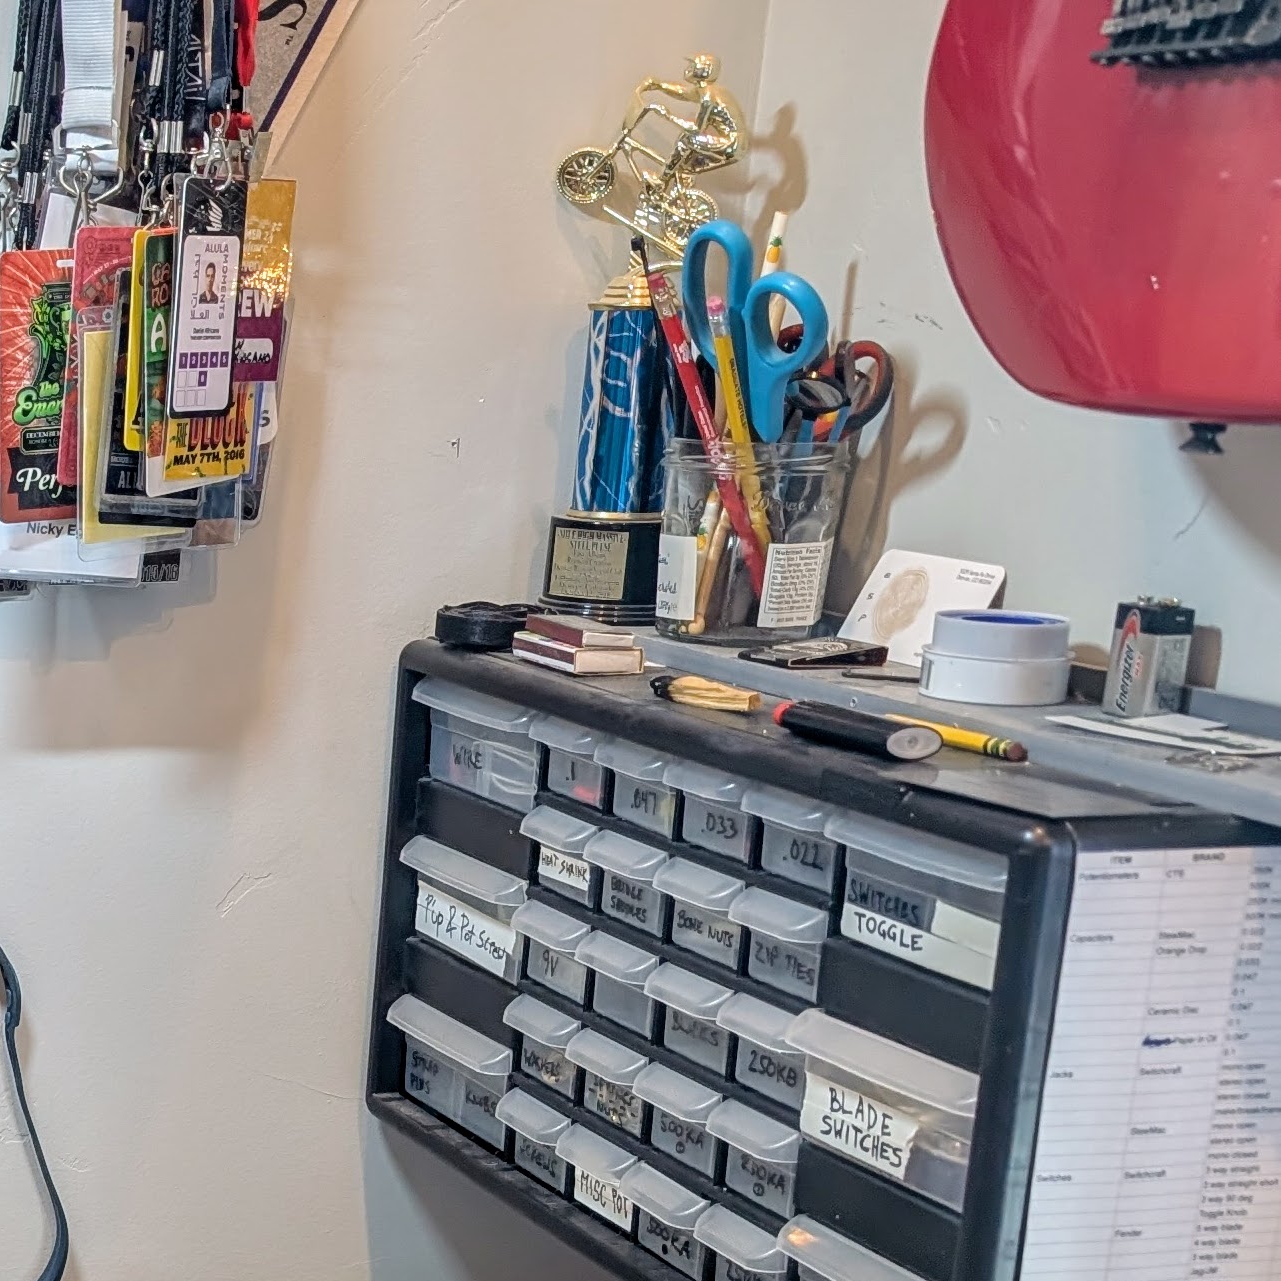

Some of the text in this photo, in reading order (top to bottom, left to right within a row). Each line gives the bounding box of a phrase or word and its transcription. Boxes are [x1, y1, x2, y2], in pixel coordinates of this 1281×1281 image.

[205, 243, 229, 254] ALULA
[218, 254, 229, 320] MOMENTS
[173, 452, 196, 466] MAY
[224, 449, 245, 461] 2016
[26, 522, 63, 537] Nicky
[452, 744, 484, 770] WIRE
[701, 811, 739, 840] .033
[1192, 852, 1225, 861] BRAND
[459, 916, 474, 944] Pot
[676, 909, 735, 949] BONE NUTS
[853, 911, 924, 952] TOGGLE
[541, 948, 559, 978] 9V
[753, 940, 816, 986] ZIP TIES
[747, 1050, 798, 1088] 250KB
[828, 1086, 893, 1139] BLADE
[819, 1115, 904, 1169] SWITCHES
[579, 1170, 629, 1219] MISC POT
[1115, 1229, 1143, 1237] Fender
